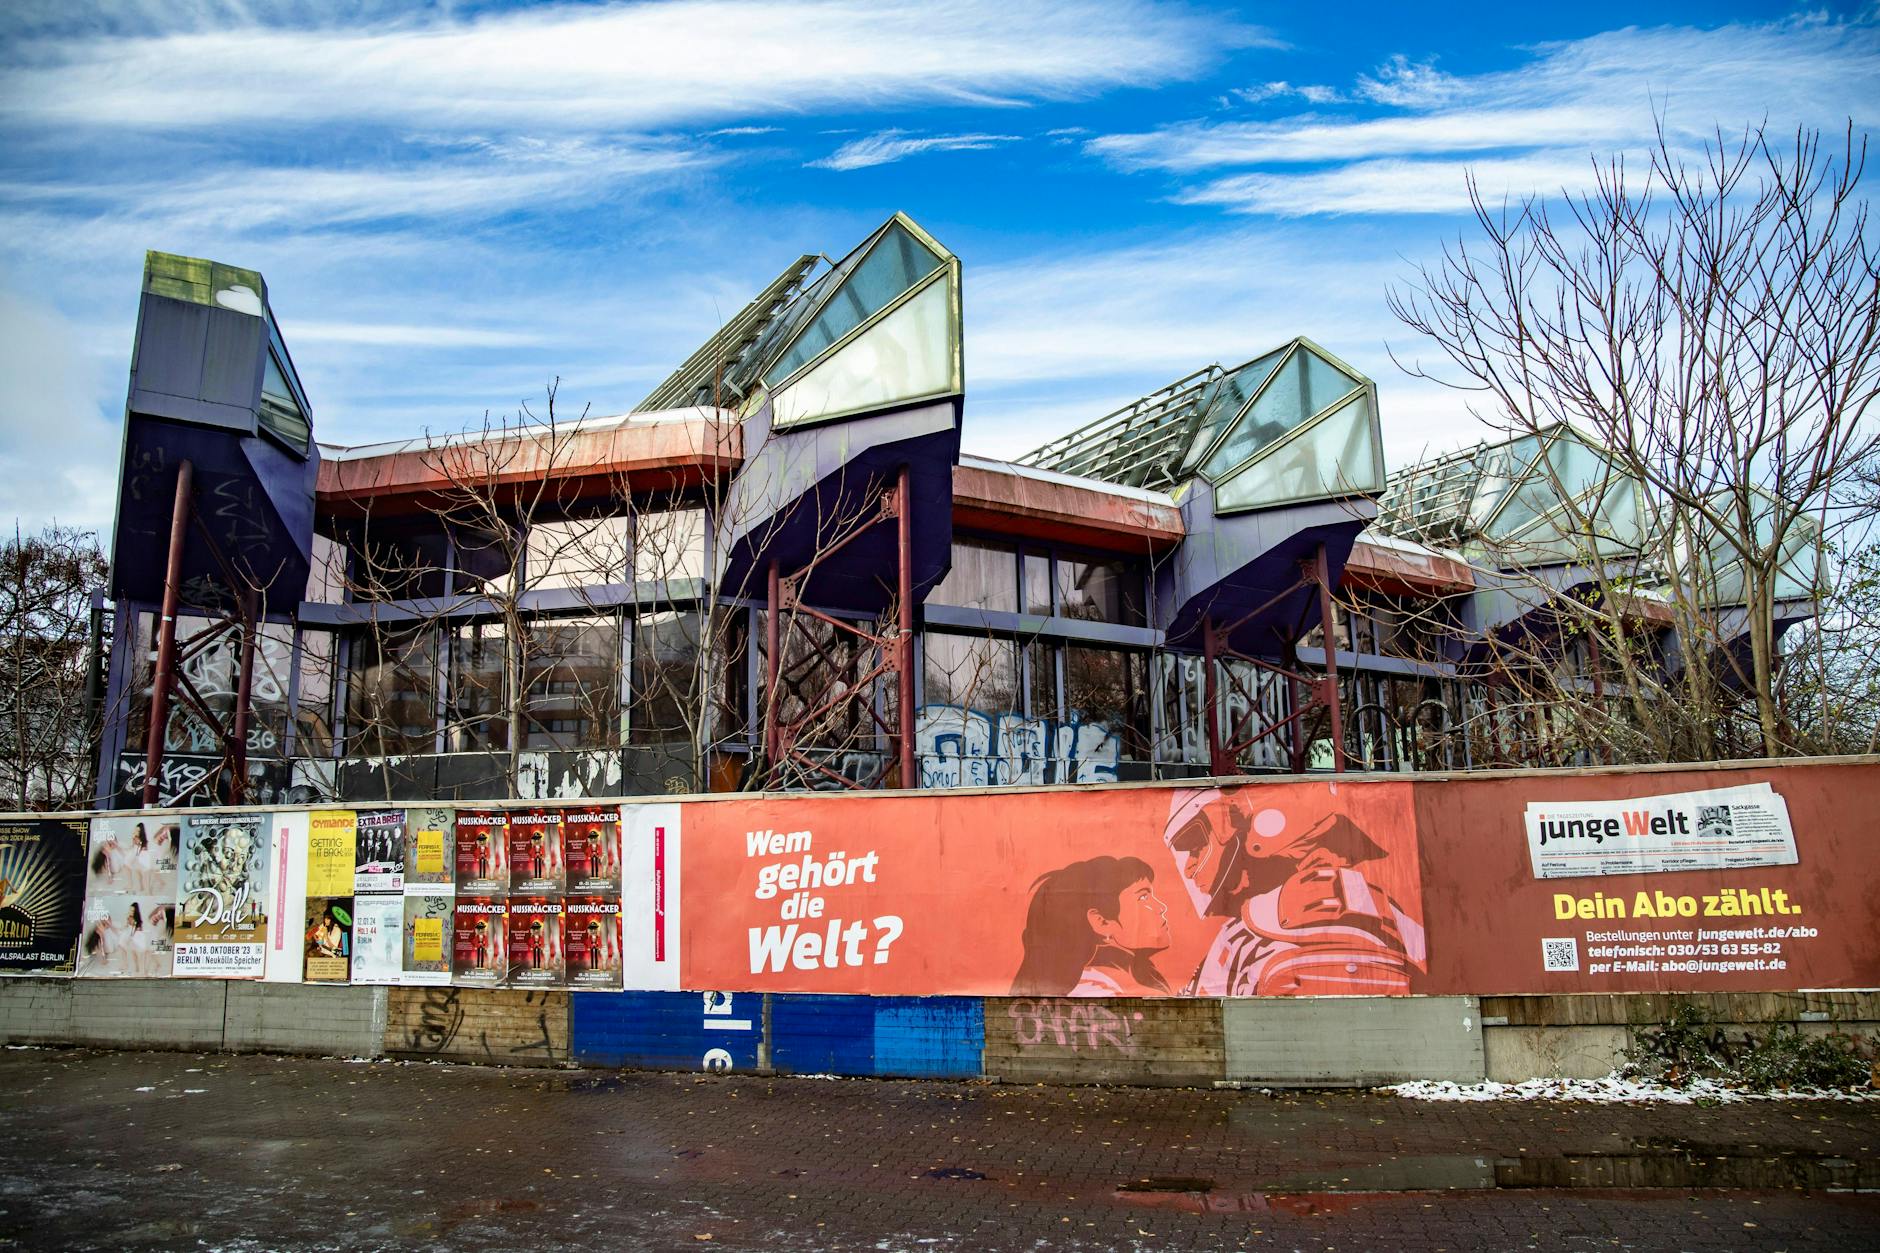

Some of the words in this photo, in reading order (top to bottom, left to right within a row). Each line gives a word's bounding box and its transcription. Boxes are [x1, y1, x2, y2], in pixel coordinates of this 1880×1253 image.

[458, 815, 507, 826] NUSSKNACKER
[512, 814, 562, 825] NUSSKNACKER
[567, 812, 620, 824] NUSSKNACKER
[1539, 814, 1620, 846] junge
[1622, 809, 1690, 837] Welt
[746, 830, 812, 857] Wem
[755, 850, 879, 900] gehört
[457, 903, 506, 914] NUSSKNACKER
[512, 902, 563, 914] NUSSKNACKER
[568, 902, 620, 914] NUSSKNACKER
[780, 892, 825, 920] die
[1553, 891, 1627, 920] Dein
[1632, 890, 1698, 919] Abo
[1702, 887, 1802, 917] zählt.
[1586, 929, 1661, 943] Bestellungen
[1662, 929, 1694, 942] unter
[1697, 926, 1818, 941] jungewelt.de/abo
[210, 946, 240, 954] OKTOBER
[749, 915, 904, 974] Welt?
[1588, 945, 1665, 958] telefonisch:
[1667, 943, 1718, 957] 030/53
[1721, 943, 1739, 955] 63
[1741, 942, 1781, 955] 55-82
[176, 955, 201, 964] BERLIN
[206, 954, 233, 965] Neukölln
[235, 955, 262, 966] Speicher
[1589, 962, 1611, 976] per
[1613, 959, 1659, 973] E-Mail:
[1661, 959, 1786, 974] abo@jungewelt.de
